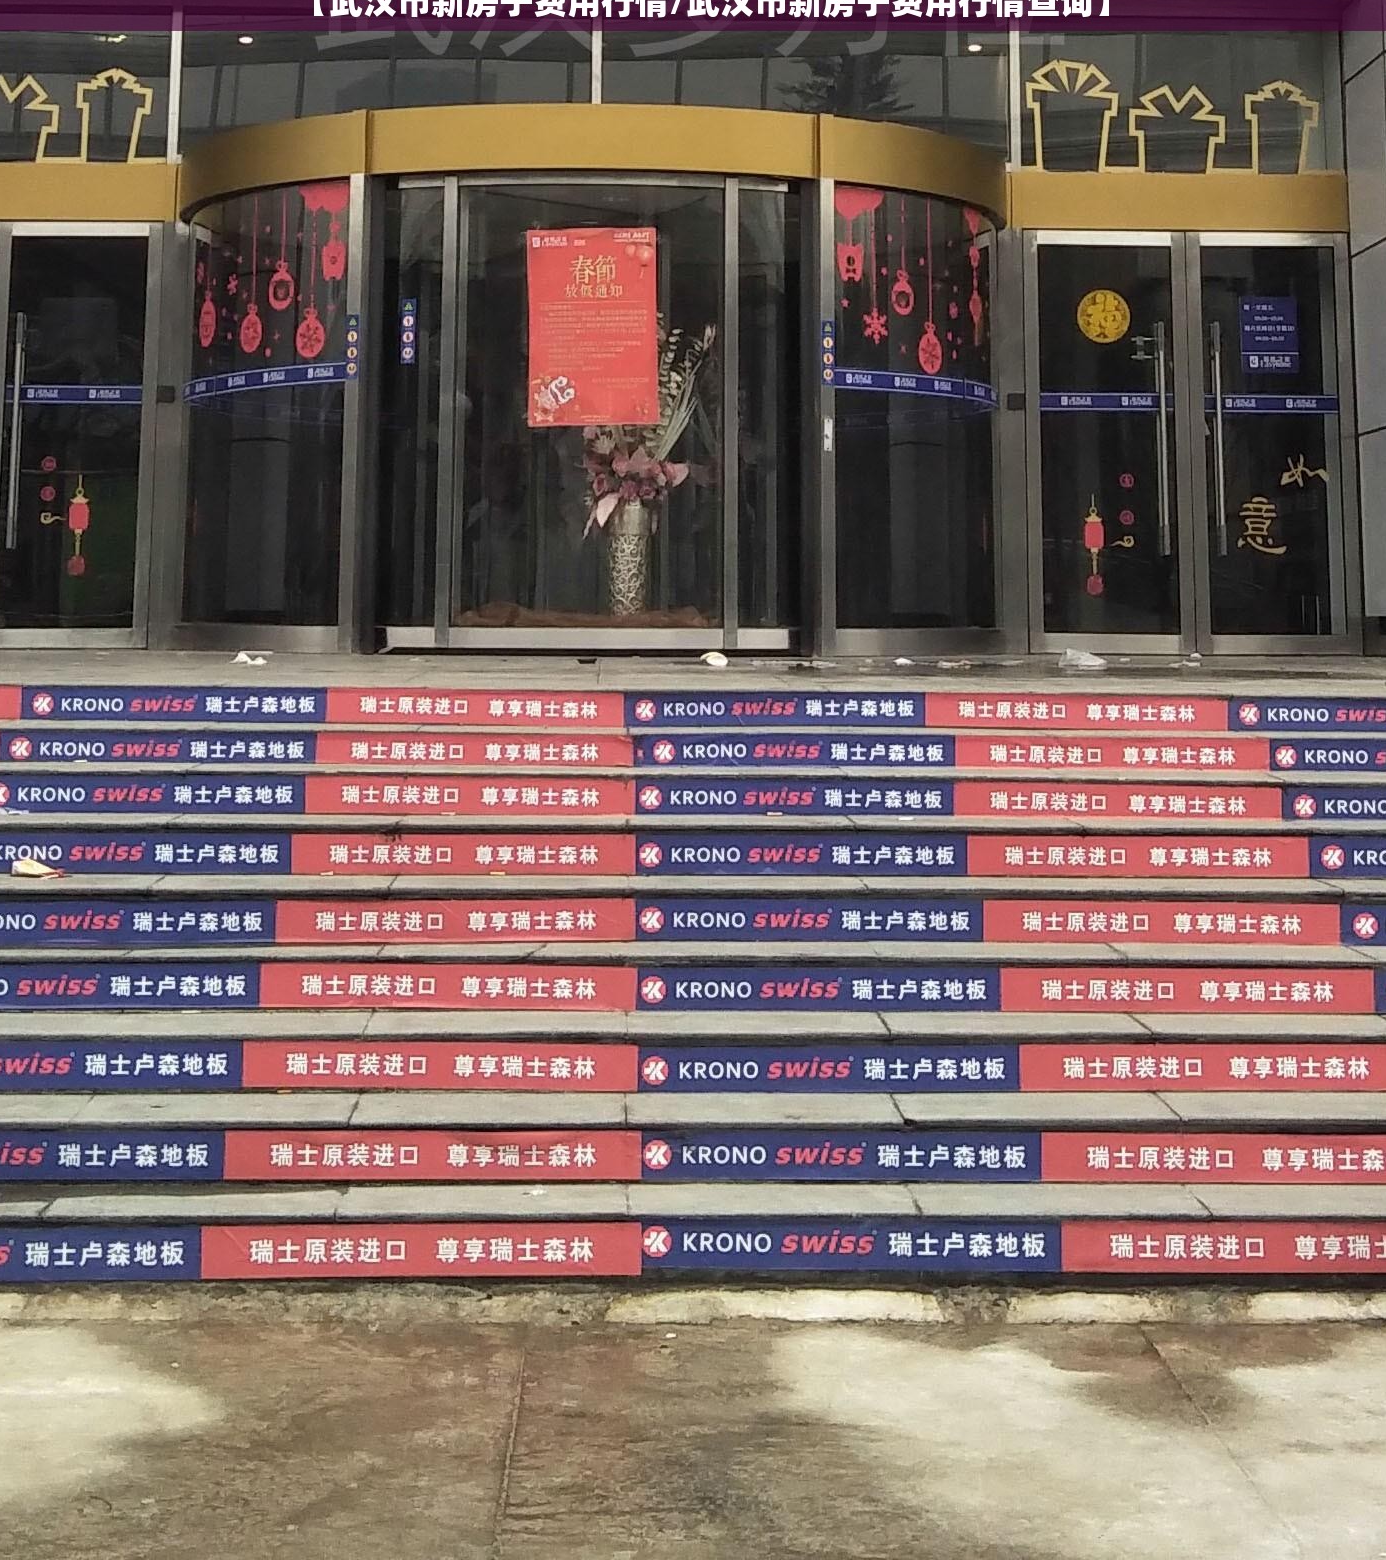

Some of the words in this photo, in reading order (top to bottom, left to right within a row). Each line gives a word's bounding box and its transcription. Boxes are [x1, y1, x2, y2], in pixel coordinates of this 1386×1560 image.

[61, 698, 123, 712] KRONO
[130, 698, 195, 712] swiss
[205, 696, 315, 713] 瑞士卢森地板
[1268, 708, 1329, 722] KRONO
[683, 744, 746, 758] KRONO
[753, 744, 820, 759] swiss
[831, 743, 944, 762] 瑞士卢森地板
[990, 745, 1101, 764] 瑞士原装进口
[1123, 747, 1235, 765] 尊享瑞士森林
[18, 787, 85, 802] KRONO
[93, 786, 163, 802] swiss
[174, 785, 293, 804] 瑞士卢森地板
[342, 785, 458, 804] 瑞士原装进口
[481, 786, 599, 807] 尊享瑞士森林
[671, 847, 740, 862] KRONO
[748, 845, 820, 863] swiss
[832, 845, 954, 865] 瑞士卢森地板
[1005, 846, 1125, 866] 瑞士原装进口
[1150, 847, 1271, 867] 尊享瑞士森林
[45, 910, 120, 929] swiss
[133, 912, 262, 932] 瑞士卢森地板
[316, 911, 443, 931] 瑞士原装进口
[469, 911, 595, 931] 尊享瑞士森林
[676, 982, 751, 998] KRONO
[761, 978, 838, 998] swiss
[852, 979, 986, 1000] 瑞士卢森地板
[1042, 980, 1173, 1000] 瑞士原装进口
[1201, 980, 1333, 1002] 尊享瑞士森林
[679, 1062, 758, 1079] KRONO
[768, 1058, 850, 1079] swiss
[864, 1057, 1005, 1080] 瑞士卢森地板
[1063, 1056, 1202, 1079] 瑞士原装进口
[1230, 1056, 1369, 1079] 尊享瑞士森林
[59, 1144, 208, 1167] 瑞士卢森地板
[271, 1143, 418, 1167] 瑞士原装进口
[447, 1144, 596, 1167] 尊享瑞士森林
[683, 1233, 771, 1252] KRONO
[782, 1231, 873, 1254] swiss
[889, 1232, 1045, 1257] 瑞士卢森地板
[1110, 1234, 1264, 1259] 瑞士原装进口
